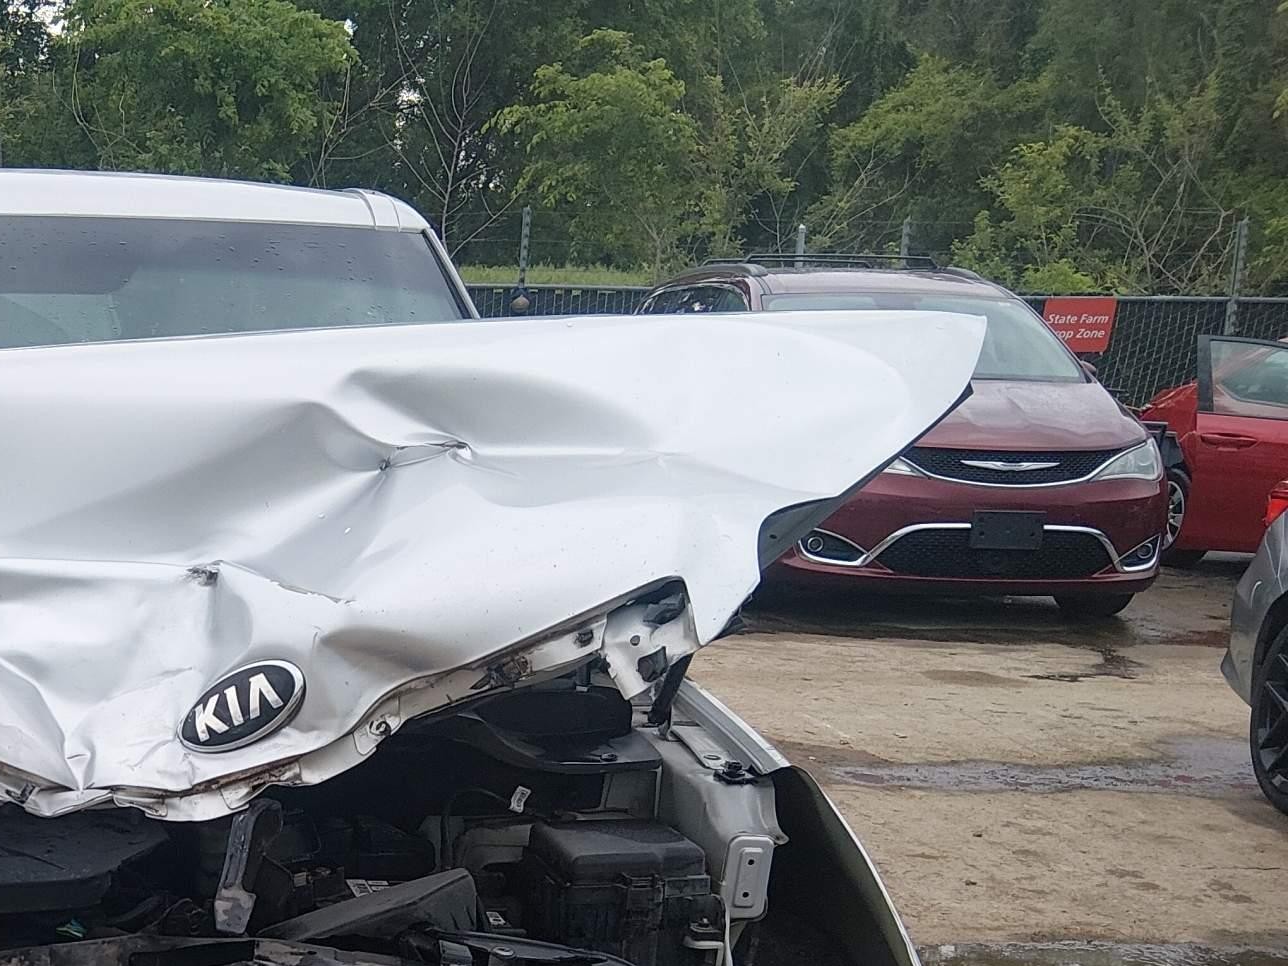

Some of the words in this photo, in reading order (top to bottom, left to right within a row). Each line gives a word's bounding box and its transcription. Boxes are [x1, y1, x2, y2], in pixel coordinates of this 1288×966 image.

[1048, 313, 1078, 324] State
[1079, 313, 1109, 324] Farm
[1075, 328, 1105, 339] Zone
[194, 672, 284, 742] KIA
